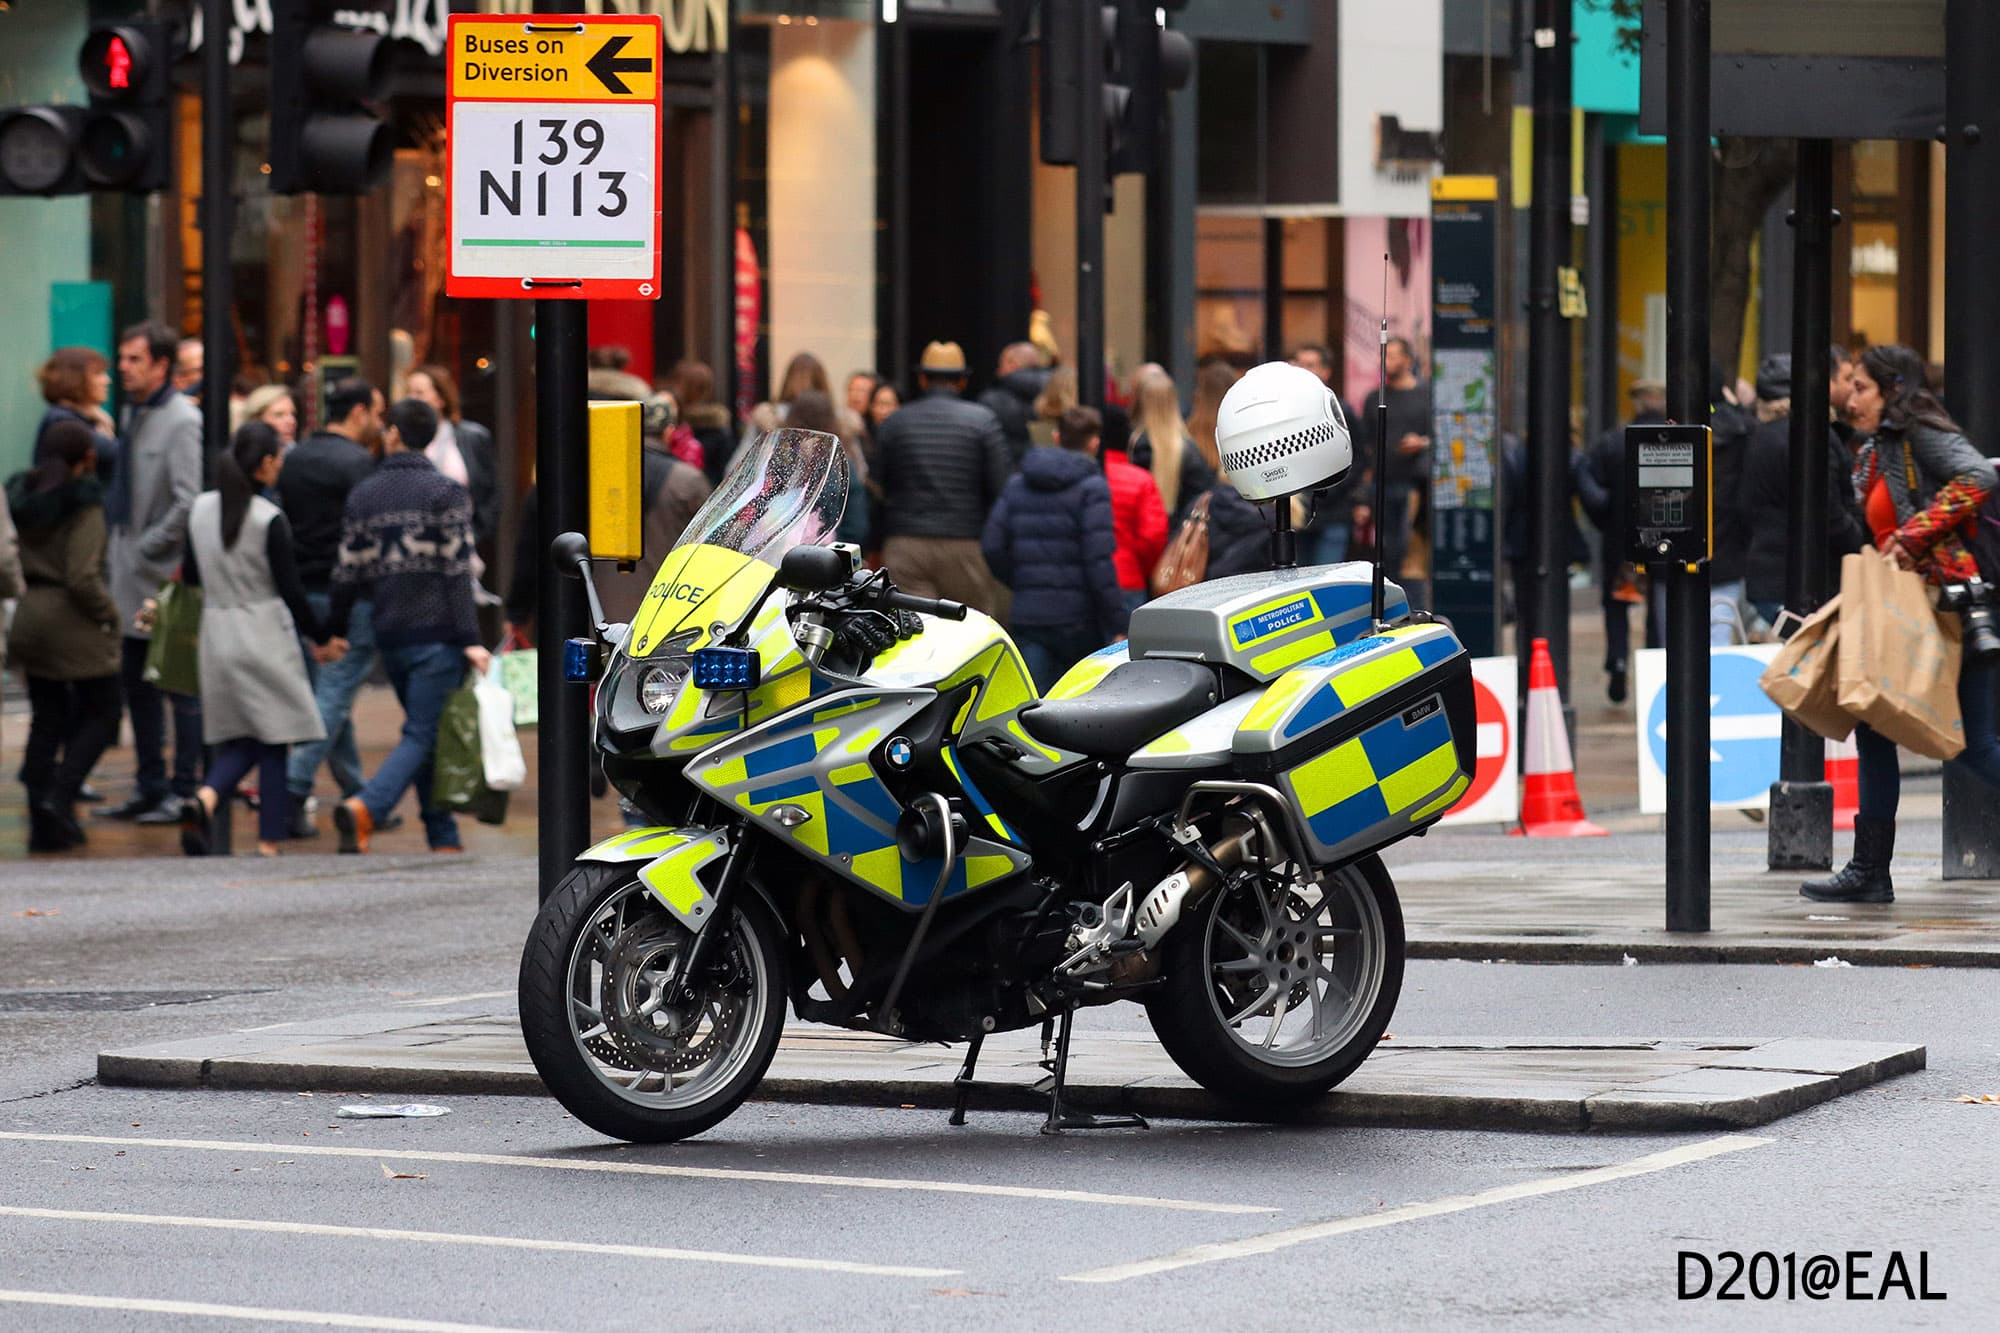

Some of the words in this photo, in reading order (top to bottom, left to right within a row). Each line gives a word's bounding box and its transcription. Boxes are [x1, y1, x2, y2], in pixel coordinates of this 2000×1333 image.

[465, 35, 528, 54] Buses
[536, 39, 564, 54] on
[464, 62, 568, 82] Diversion
[514, 119, 604, 166] 139
[480, 170, 628, 217] N113
[1258, 602, 1304, 624] METROPOLITAN
[1267, 612, 1302, 631] POLICE
[1412, 703, 1431, 720] BMW
